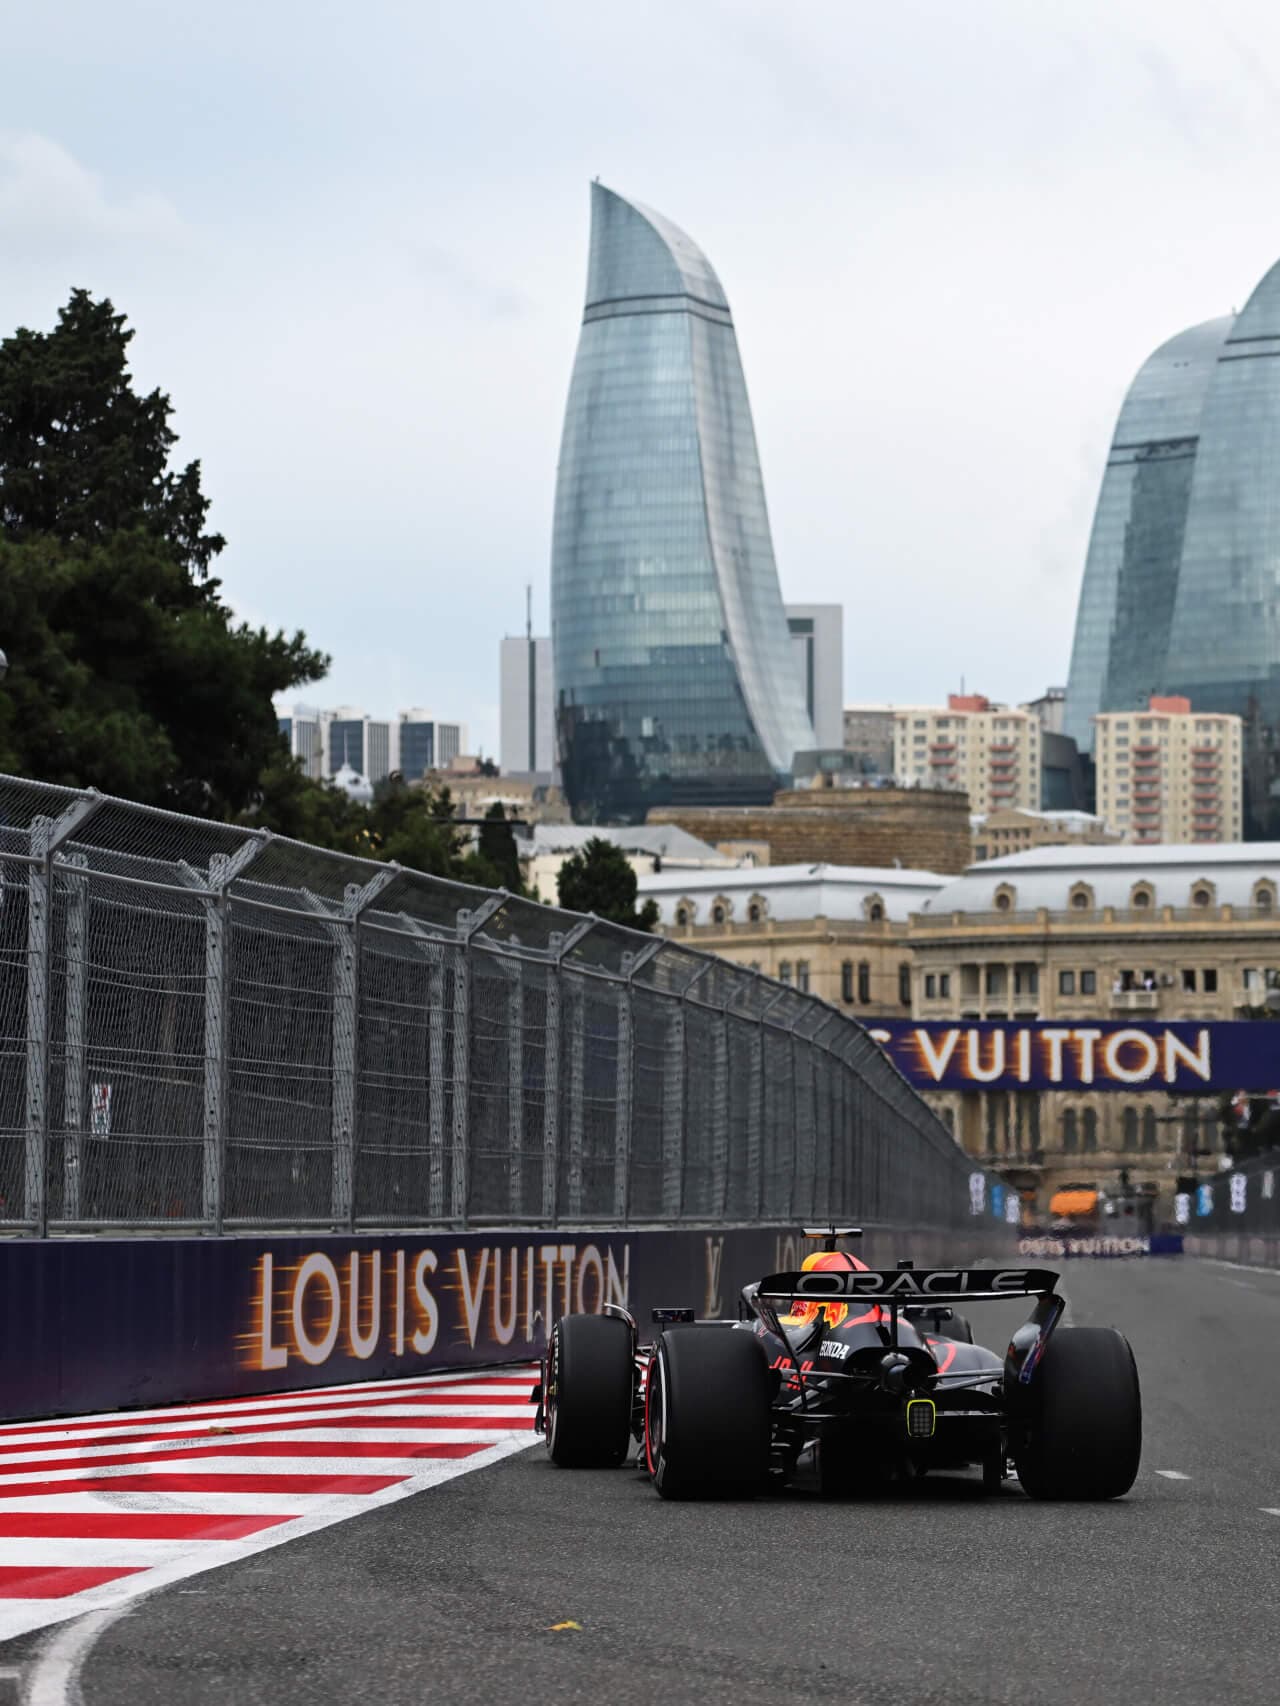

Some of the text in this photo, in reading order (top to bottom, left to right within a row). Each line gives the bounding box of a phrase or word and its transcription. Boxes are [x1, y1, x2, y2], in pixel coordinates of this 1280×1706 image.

[914, 1029, 1211, 1084] VUITTON
[258, 1249, 439, 1371] LOUIS
[456, 1243, 630, 1350] VUITTON
[797, 1271, 1028, 1295] ORACLE
